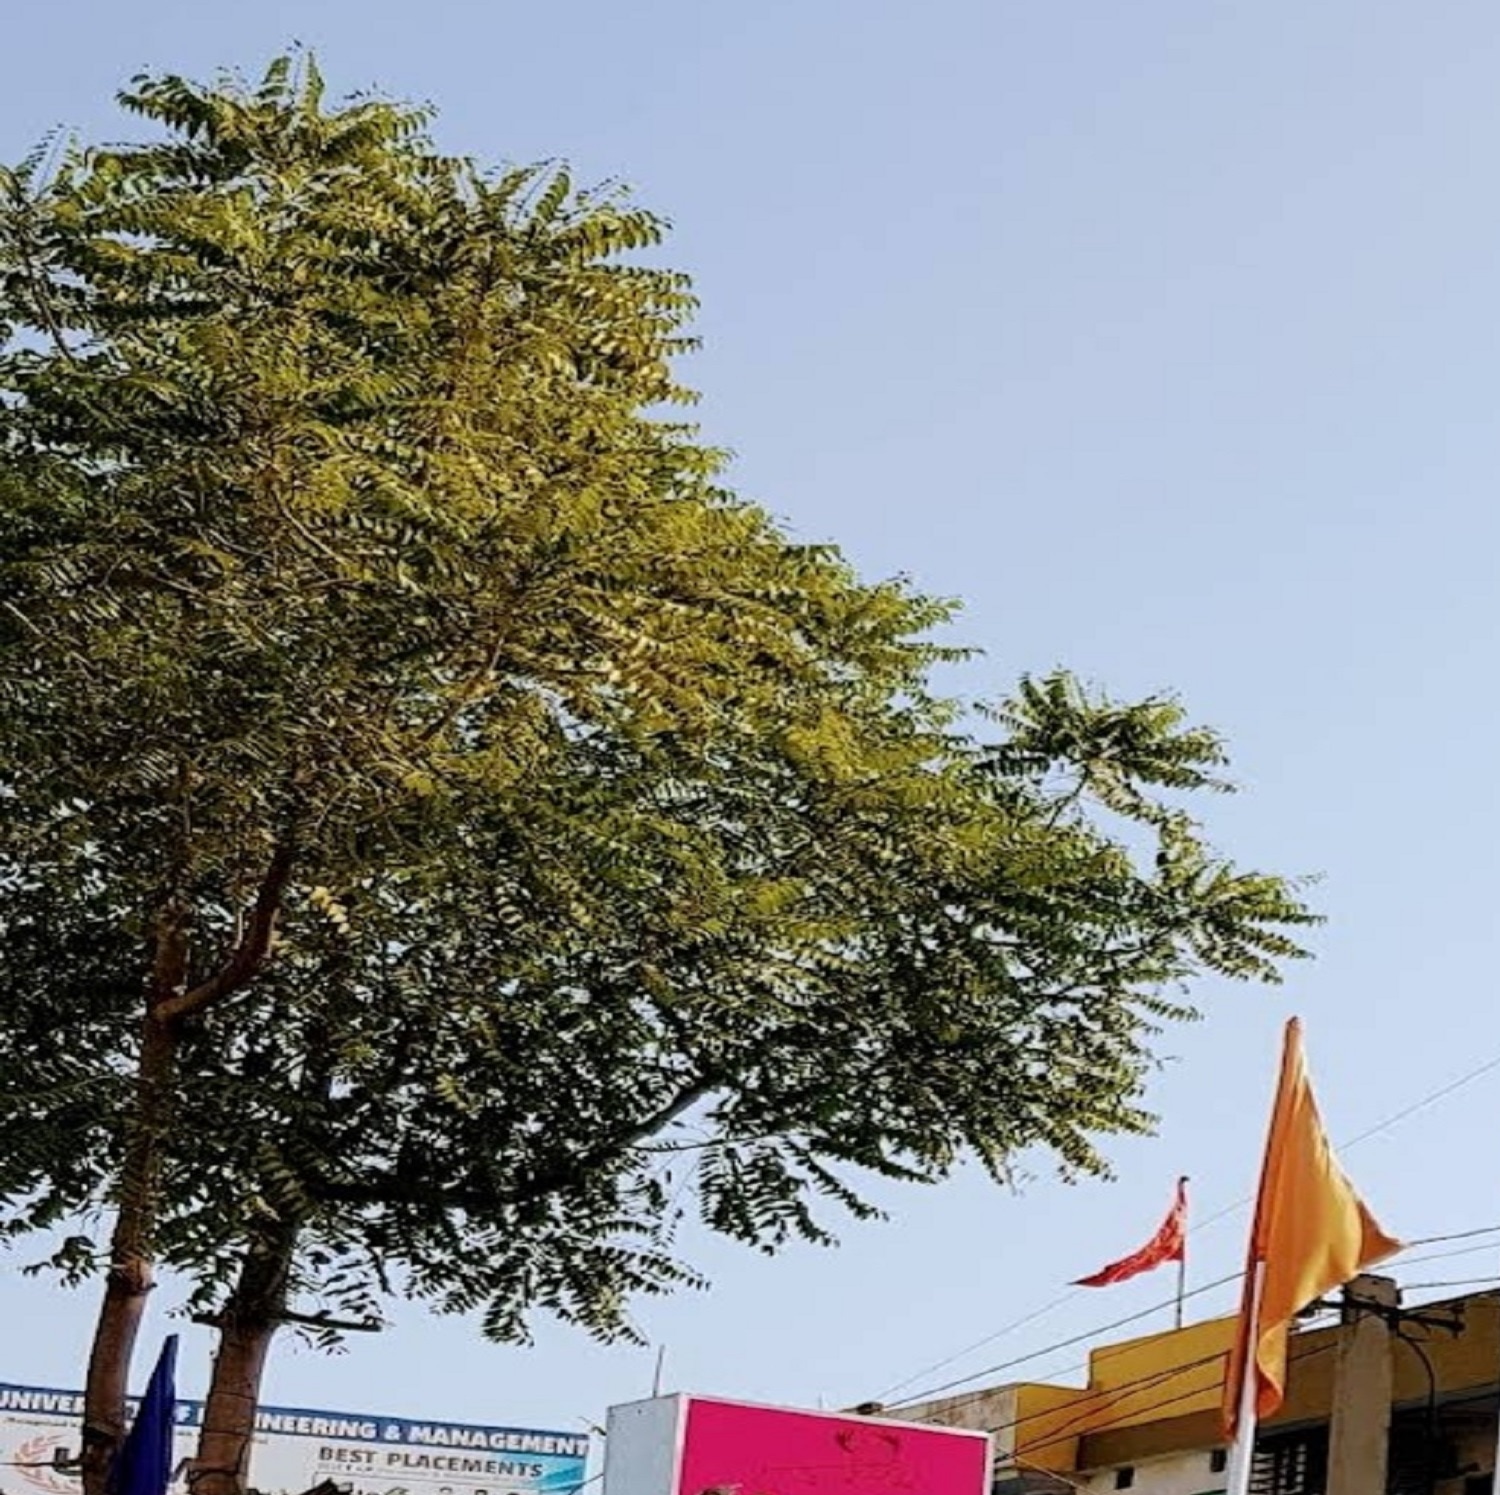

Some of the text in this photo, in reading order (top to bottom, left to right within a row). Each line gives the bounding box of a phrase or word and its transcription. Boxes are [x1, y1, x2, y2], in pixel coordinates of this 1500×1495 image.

[198, 1407, 377, 1439] INEERING
[384, 1423, 402, 1441] &
[408, 1424, 588, 1456] MANAGEMENT
[319, 1446, 377, 1464] BEST
[386, 1452, 544, 1478] PLACEMENTS
